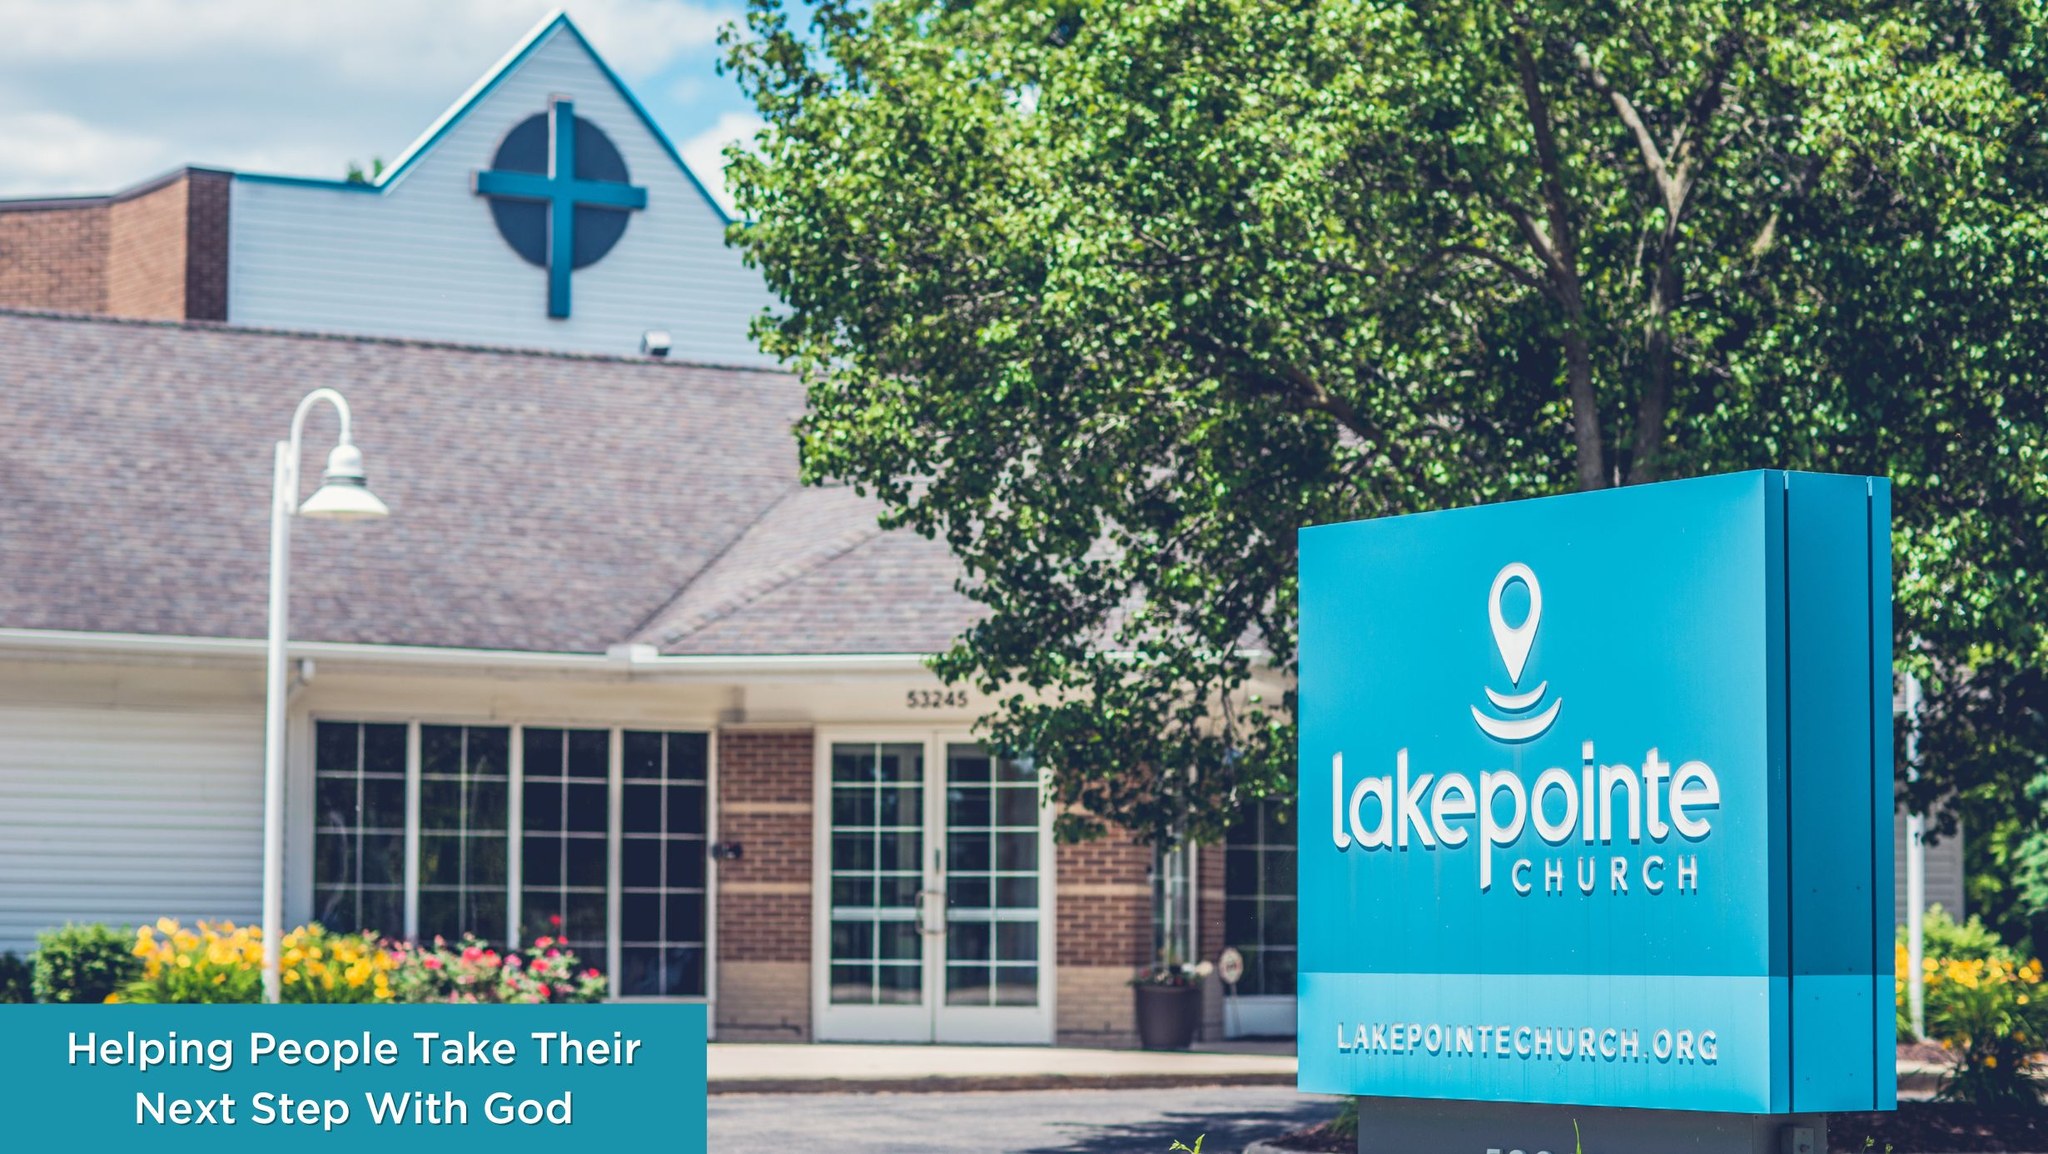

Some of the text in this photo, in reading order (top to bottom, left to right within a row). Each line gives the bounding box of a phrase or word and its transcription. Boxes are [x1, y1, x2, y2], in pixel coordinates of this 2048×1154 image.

[906, 690, 968, 708] 53245
[1332, 740, 1720, 890] lakepointe
[1512, 854, 1698, 893] CHURCH
[1337, 1022, 1718, 1062] LAKEPOINTECHURCH.ORG
